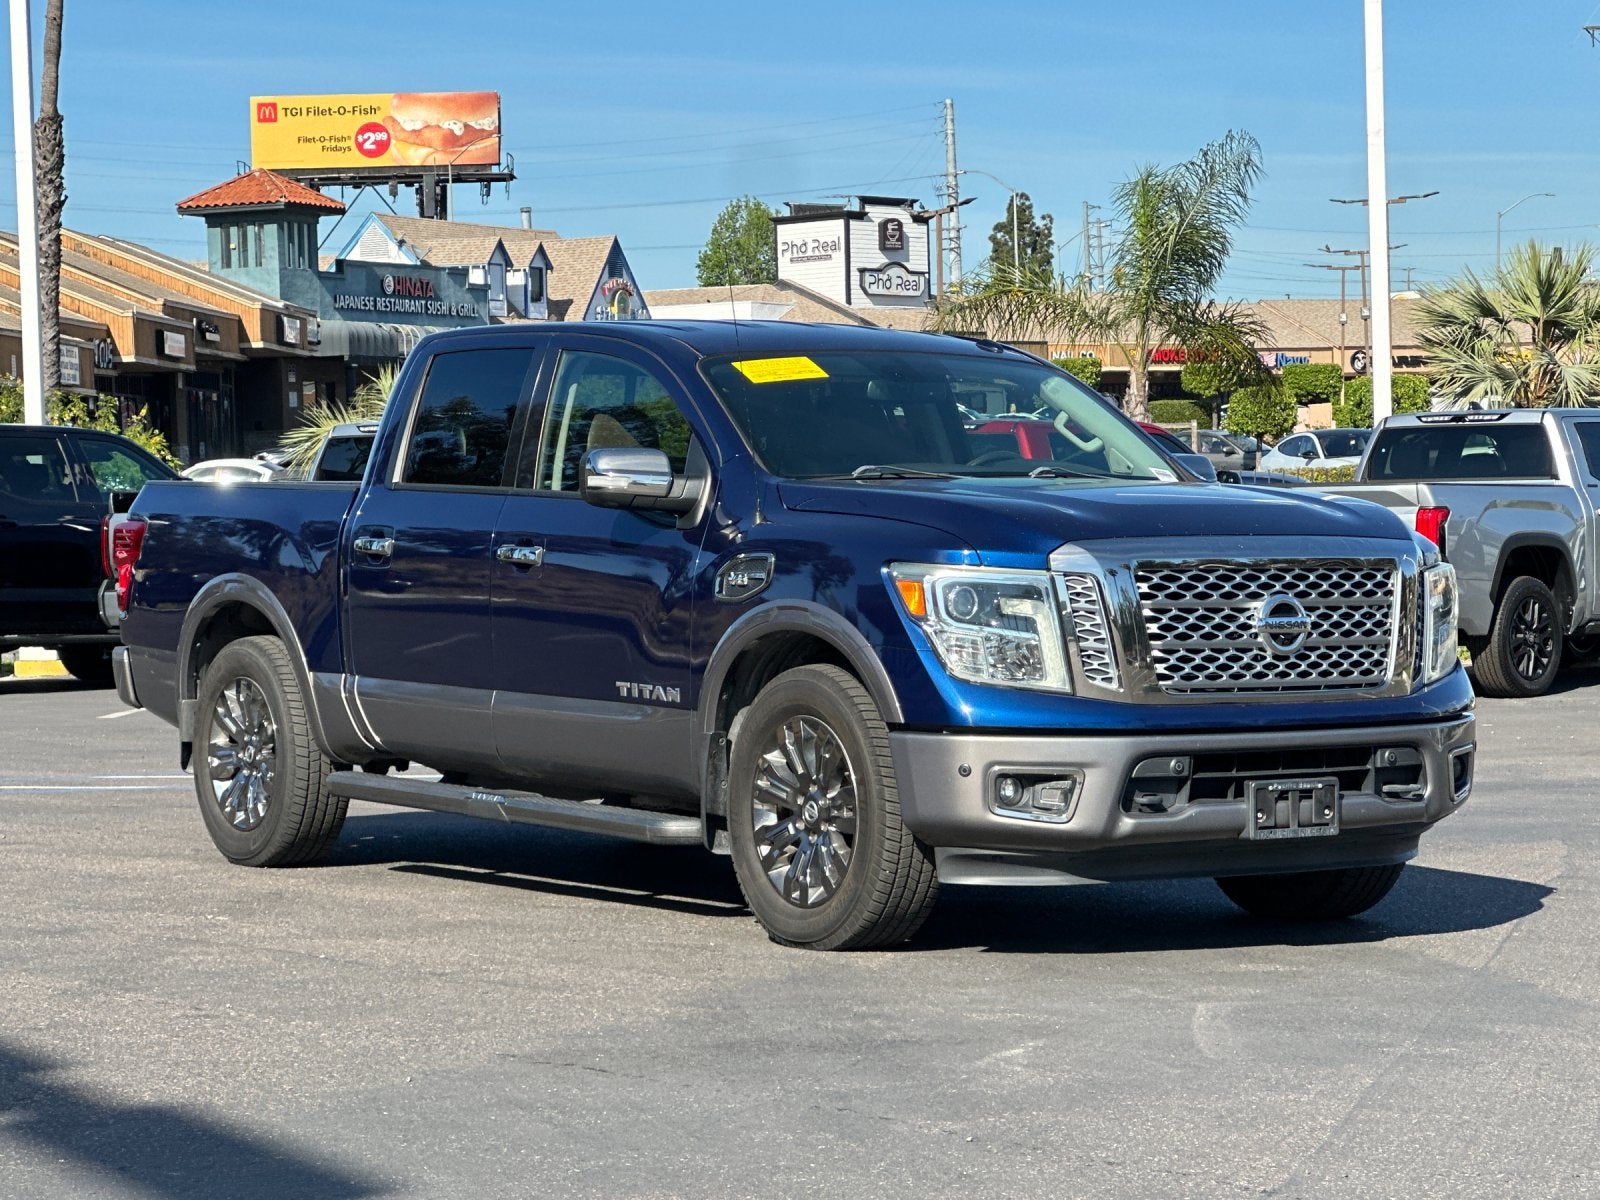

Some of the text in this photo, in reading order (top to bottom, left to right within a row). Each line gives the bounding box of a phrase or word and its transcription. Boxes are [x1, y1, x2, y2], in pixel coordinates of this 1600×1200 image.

[282, 107, 303, 117] TGI
[321, 144, 352, 153] Fridays
[812, 236, 841, 254] Real
[394, 275, 434, 297] HINATA
[896, 275, 921, 291] Real
[335, 294, 479, 317] JAPANESE RESTAURANT SUSHI & GRILL
[1264, 620, 1307, 629] NISSAN
[615, 681, 681, 703] TITAN
